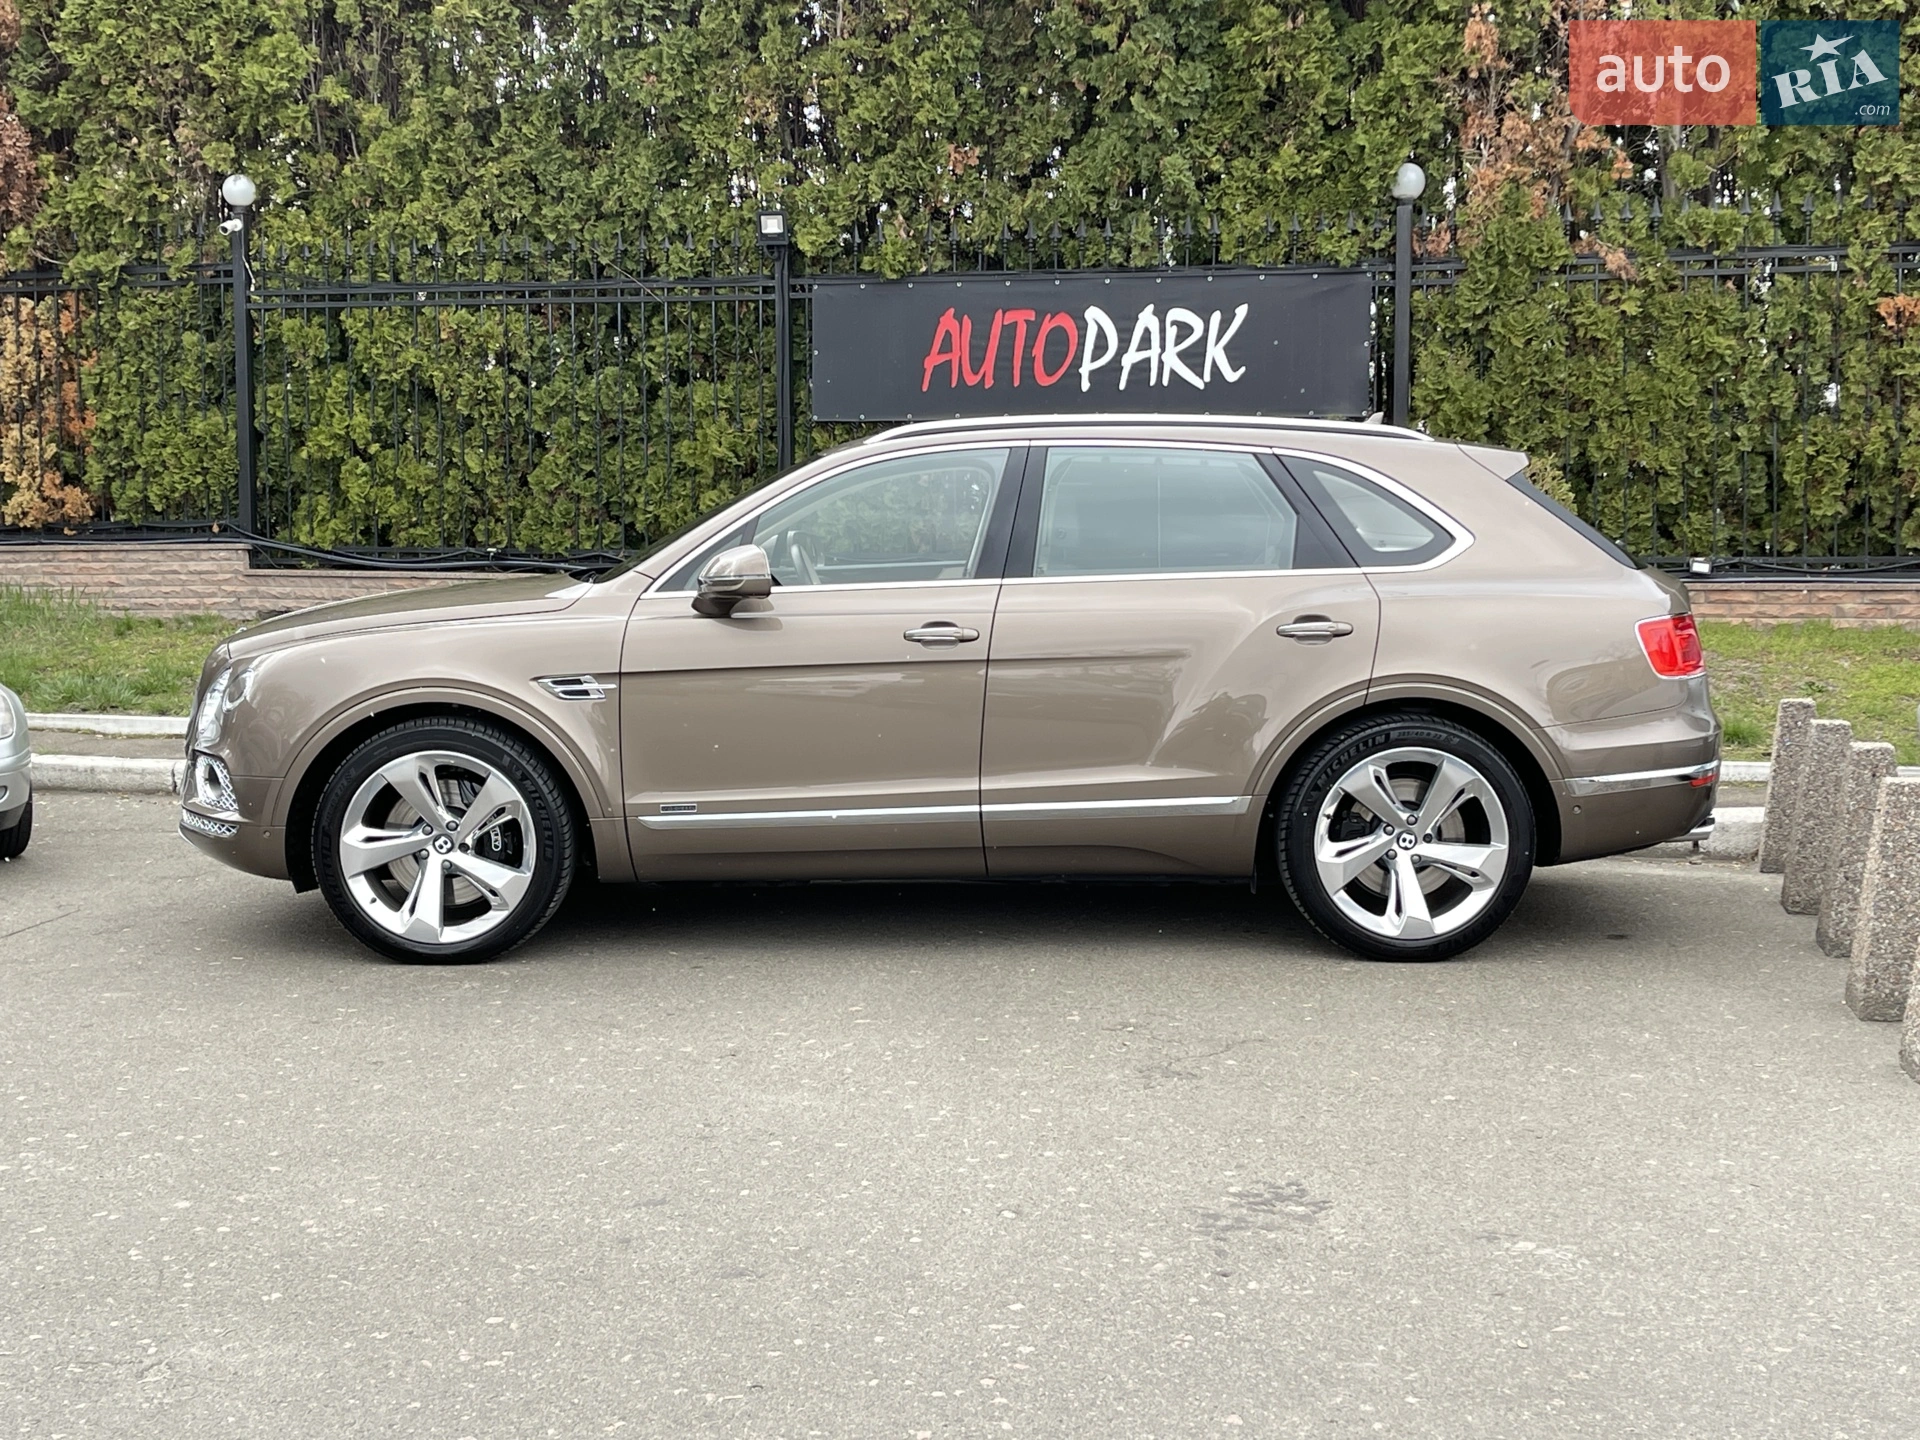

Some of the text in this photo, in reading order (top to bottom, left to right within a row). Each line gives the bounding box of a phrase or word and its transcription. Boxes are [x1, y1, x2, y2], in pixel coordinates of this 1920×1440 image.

[921, 303, 1248, 391] AUTOPARK
[1317, 734, 1385, 788] MICHELIN
[434, 836, 452, 853] B
[523, 779, 553, 858] MICHELIN
